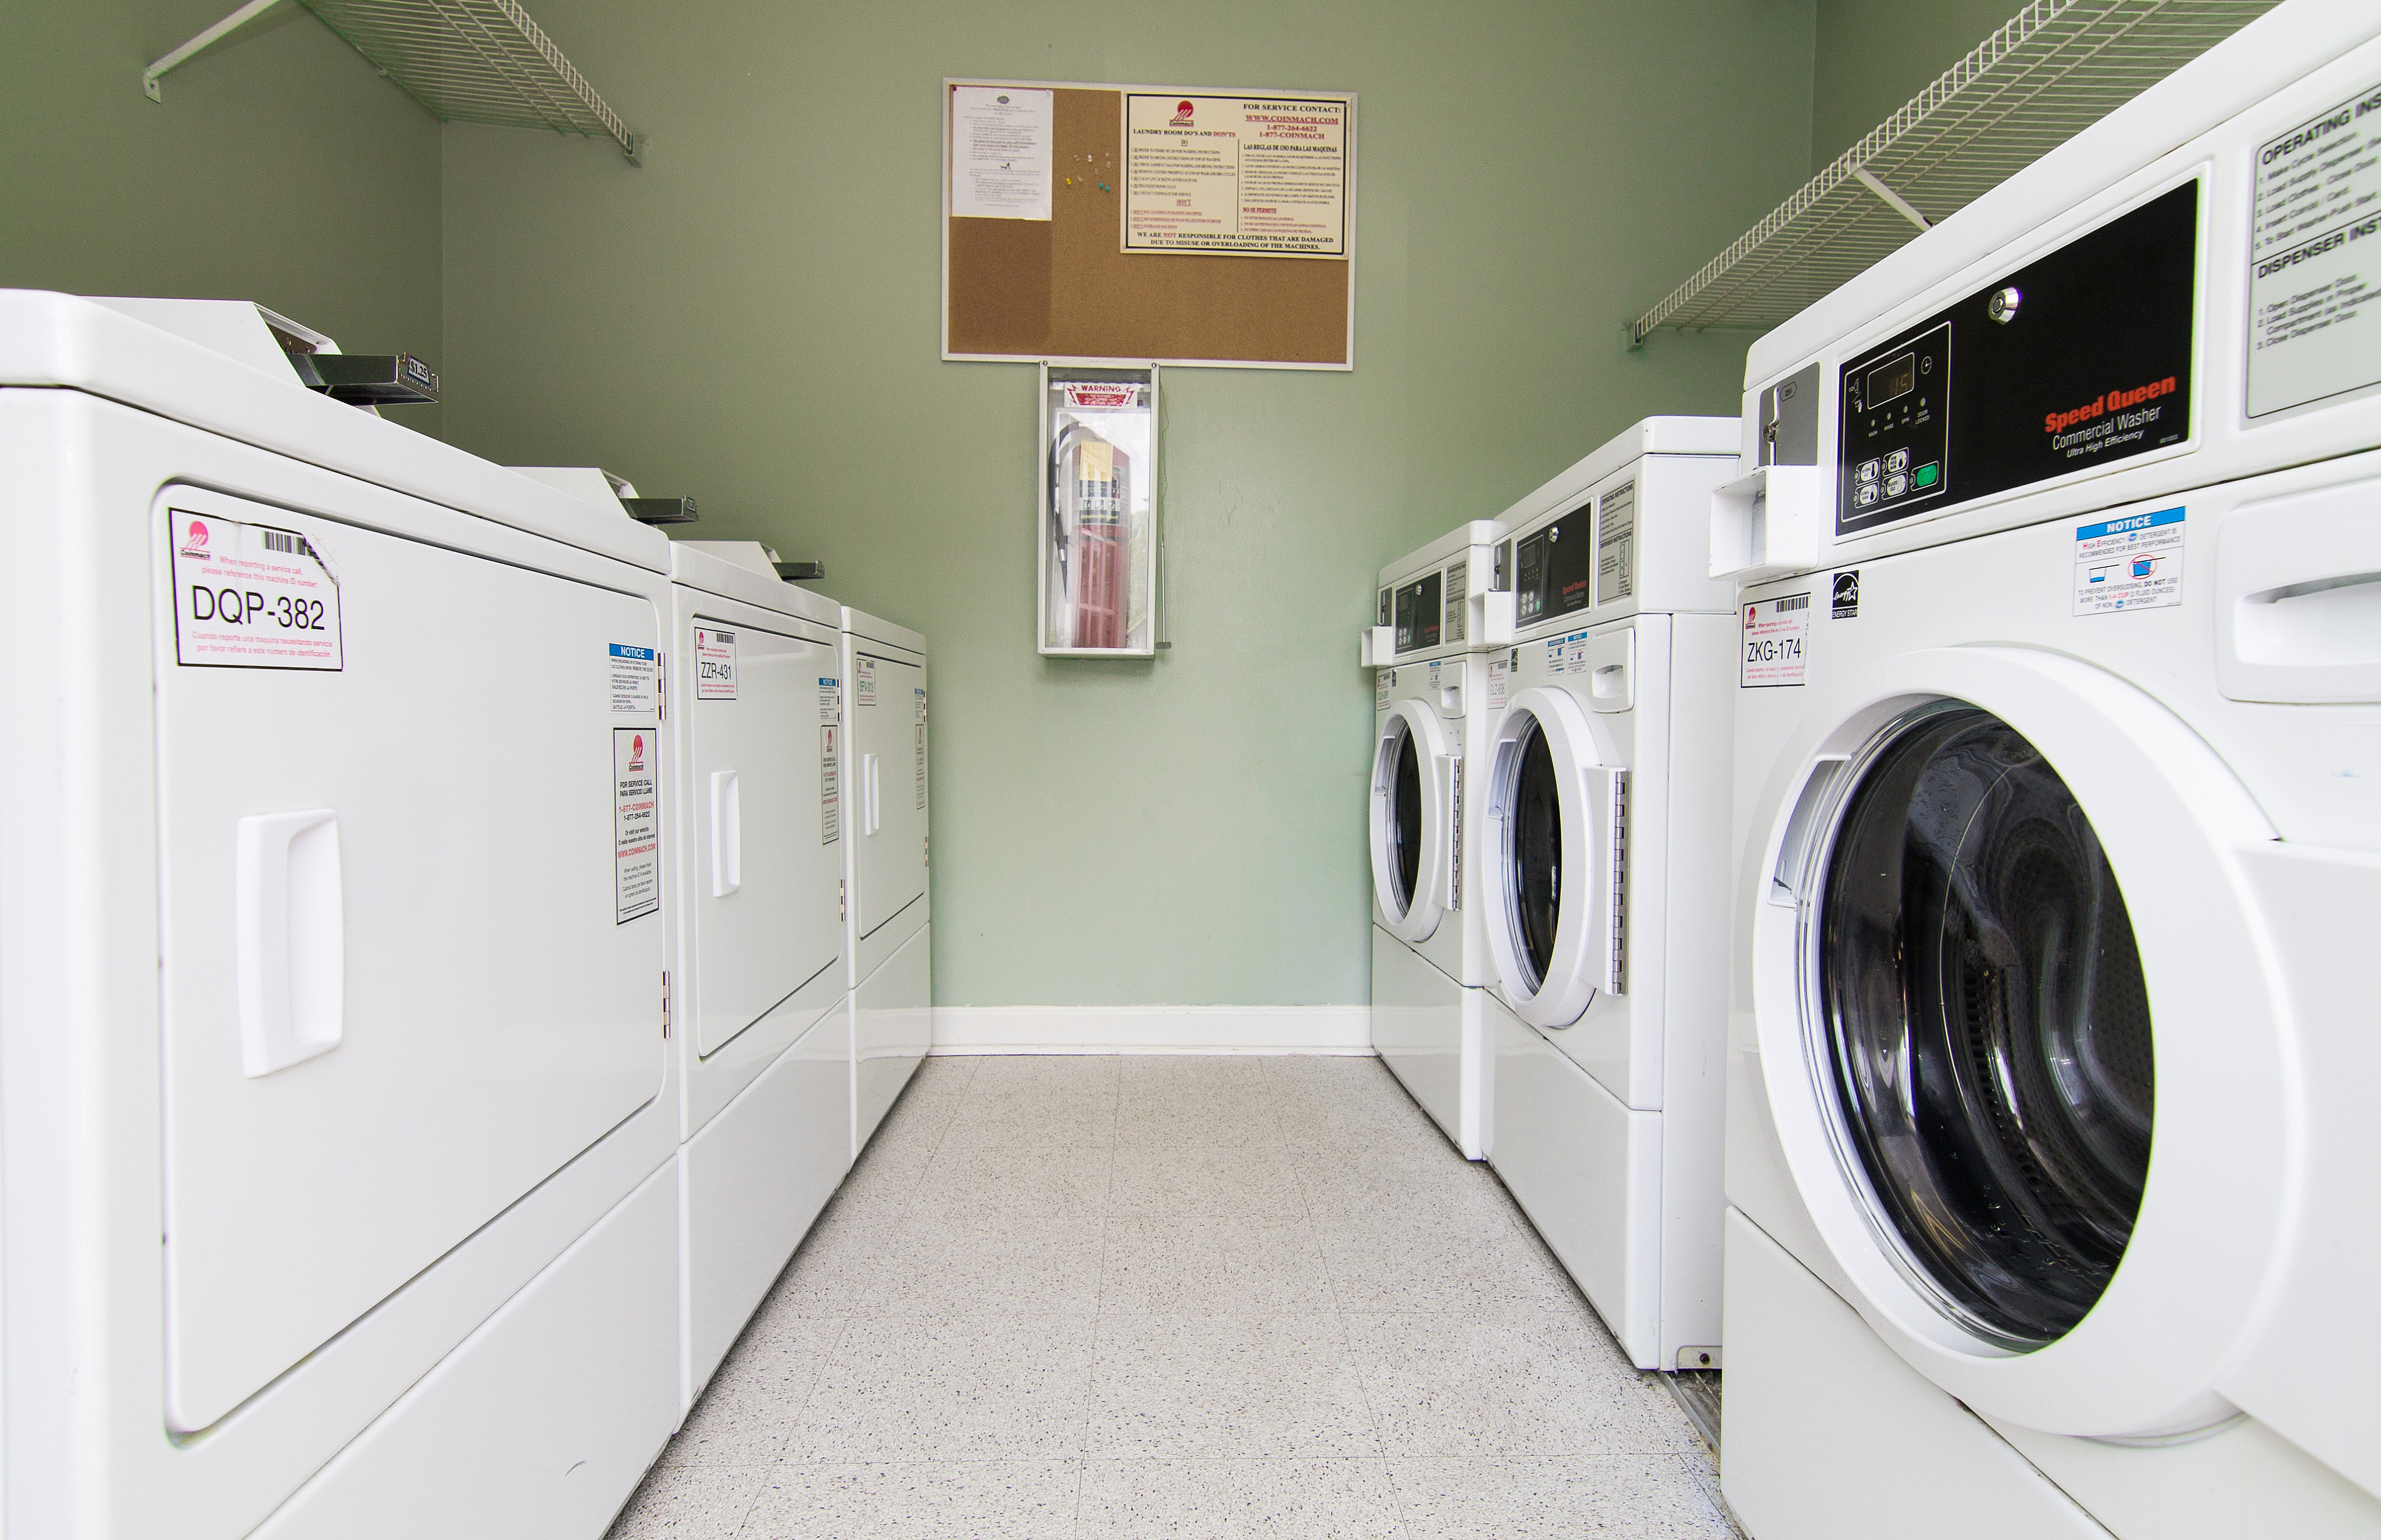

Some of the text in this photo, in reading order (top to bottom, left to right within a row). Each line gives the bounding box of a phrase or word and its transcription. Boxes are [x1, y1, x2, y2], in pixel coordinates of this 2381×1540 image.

[1246, 115, 1338, 124] WWW.COINMACH.COM
[2262, 108, 2352, 166] OPERATING
[2258, 233, 2346, 278] DISPENSER
[410, 361, 427, 378] $1.25
[2044, 376, 2176, 433] Speed Queen
[1915, 415, 1930, 424] LOCKED
[2053, 406, 2162, 451] Commercial Washer
[2067, 446, 2084, 458] Ultra
[2085, 440, 2103, 453] High
[2104, 430, 2145, 447] Efficiency
[2106, 516, 2152, 533] NOTICE
[2140, 529, 2171, 540] DETERGENT
[180, 549, 210, 559] Coinmach
[2079, 547, 2115, 559] RECOMMENDED
[2127, 542, 2140, 551] BEST
[2141, 535, 2181, 548] PERFORMANCE
[219, 556, 237, 565] When
[238, 560, 265, 571] reporting
[271, 564, 291, 573] service
[292, 568, 303, 576] call,
[202, 566, 222, 576] please
[223, 569, 252, 579] reference
[253, 573, 264, 581] this
[266, 576, 289, 584] machine
[296, 580, 319, 588] number:
[192, 584, 325, 630] DQP-382
[2126, 596, 2157, 606] DETERGENT
[1847, 609, 1857, 617] STAR
[227, 645, 247, 653] refiere
[620, 646, 645, 658] NOTICE
[1747, 638, 1801, 662] ZKG-174
[700, 662, 731, 680] ZZR-431
[628, 780, 643, 788] SERVICE
